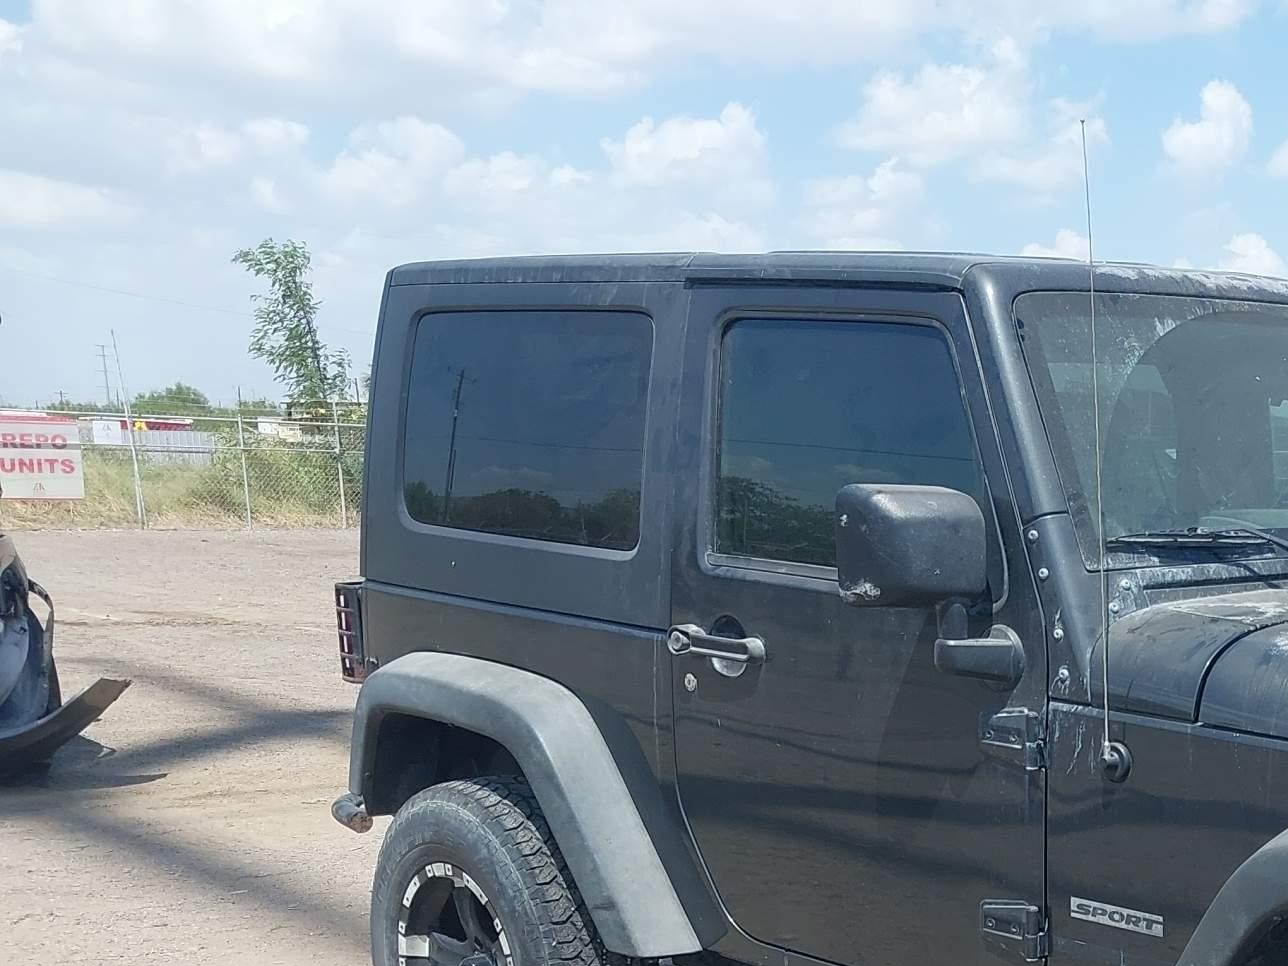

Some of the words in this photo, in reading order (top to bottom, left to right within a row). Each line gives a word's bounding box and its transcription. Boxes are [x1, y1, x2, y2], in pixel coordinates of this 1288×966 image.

[1, 432, 67, 450] REPO
[0, 457, 75, 474] UNITS
[1073, 902, 1162, 931] SPORT
